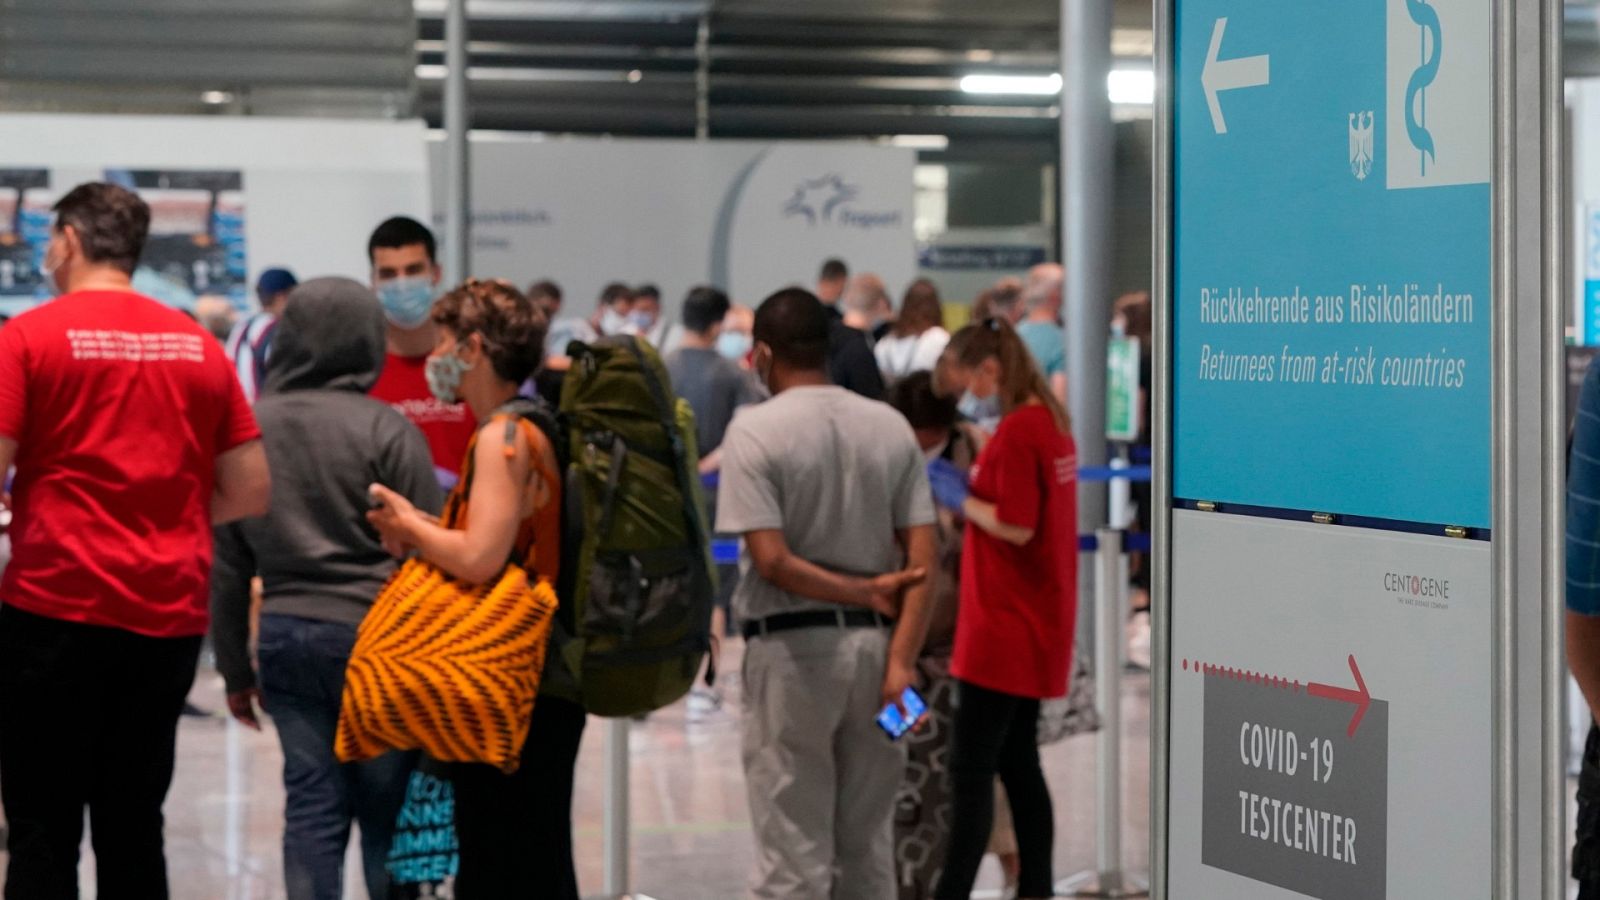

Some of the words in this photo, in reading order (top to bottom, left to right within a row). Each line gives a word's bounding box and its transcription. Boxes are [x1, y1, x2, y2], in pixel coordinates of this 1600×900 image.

[1200, 286, 1309, 323] Rückkehrende
[1314, 294, 1344, 323] aus
[1350, 283, 1473, 323] Risikoländern
[1200, 344, 1275, 382] Returnees
[1279, 345, 1316, 382] from
[1321, 346, 1376, 385] at-risk
[1381, 348, 1465, 388] countries
[1384, 572, 1449, 598] CENTOGENE
[1240, 721, 1334, 784] COVID-19
[1239, 790, 1356, 865] TESTCENTER
